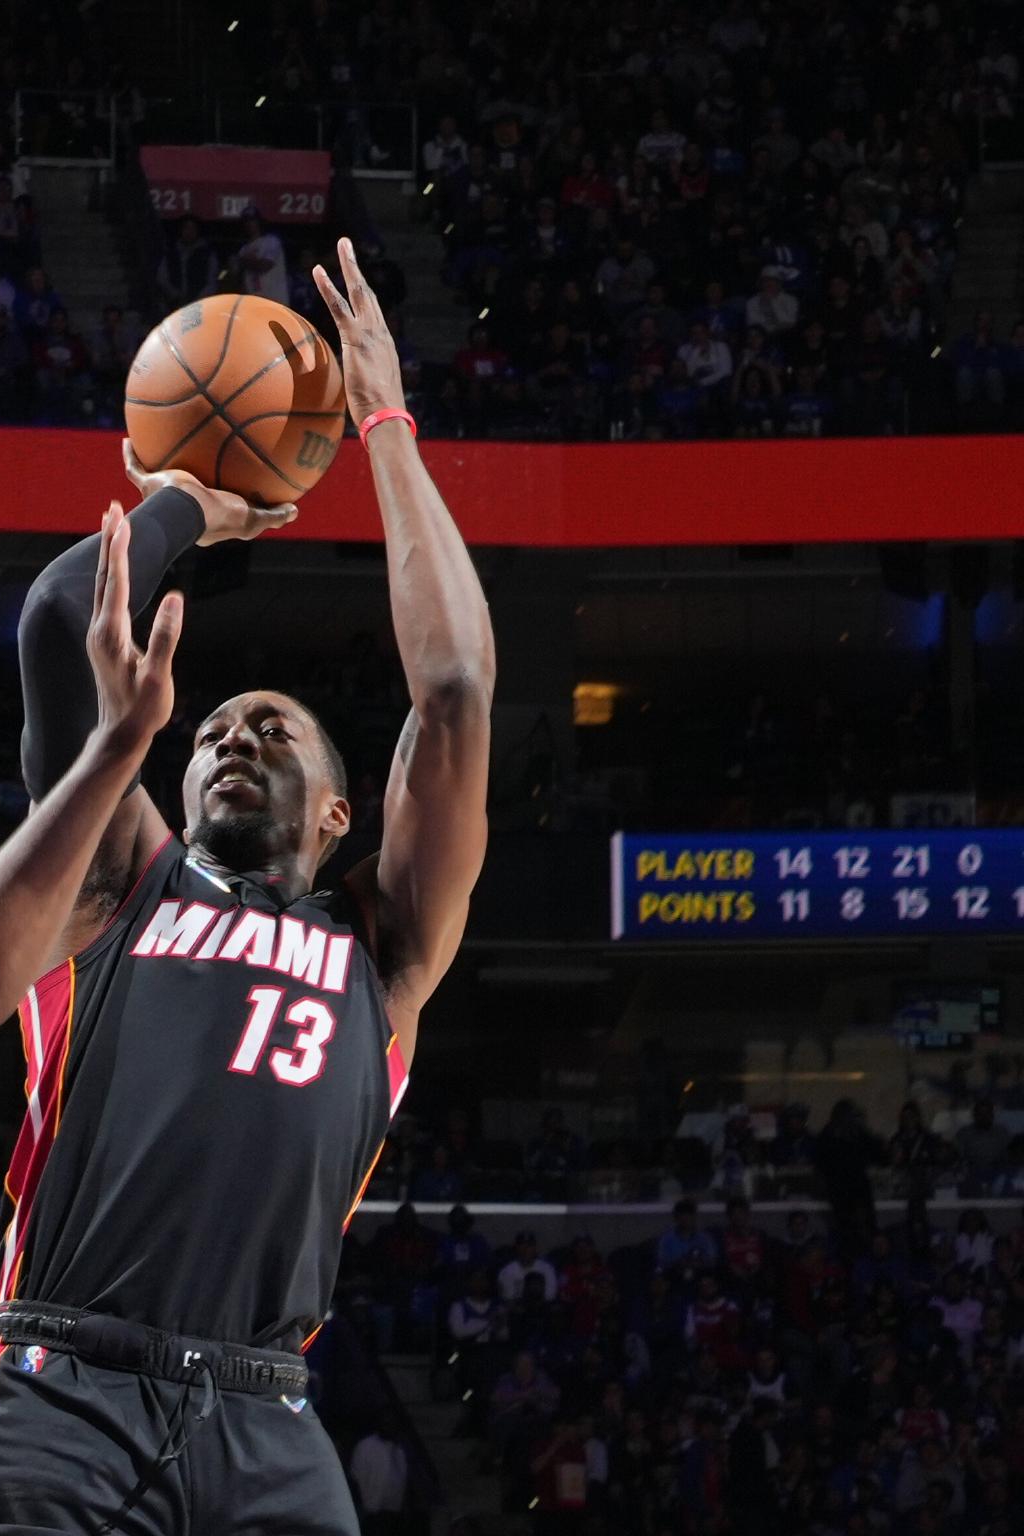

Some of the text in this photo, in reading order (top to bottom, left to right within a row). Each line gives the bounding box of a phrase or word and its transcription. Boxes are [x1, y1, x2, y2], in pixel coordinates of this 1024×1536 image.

[279, 192, 326, 215] 220
[635, 842, 984, 882] PLAYER 14 12 21 0
[638, 890, 756, 924] POINTS
[778, 887, 811, 922] 11
[839, 886, 866, 922] 8
[892, 885, 931, 921] 15
[951, 885, 991, 920] 12
[128, 897, 354, 994] MIAMI
[227, 984, 338, 1088] 13
